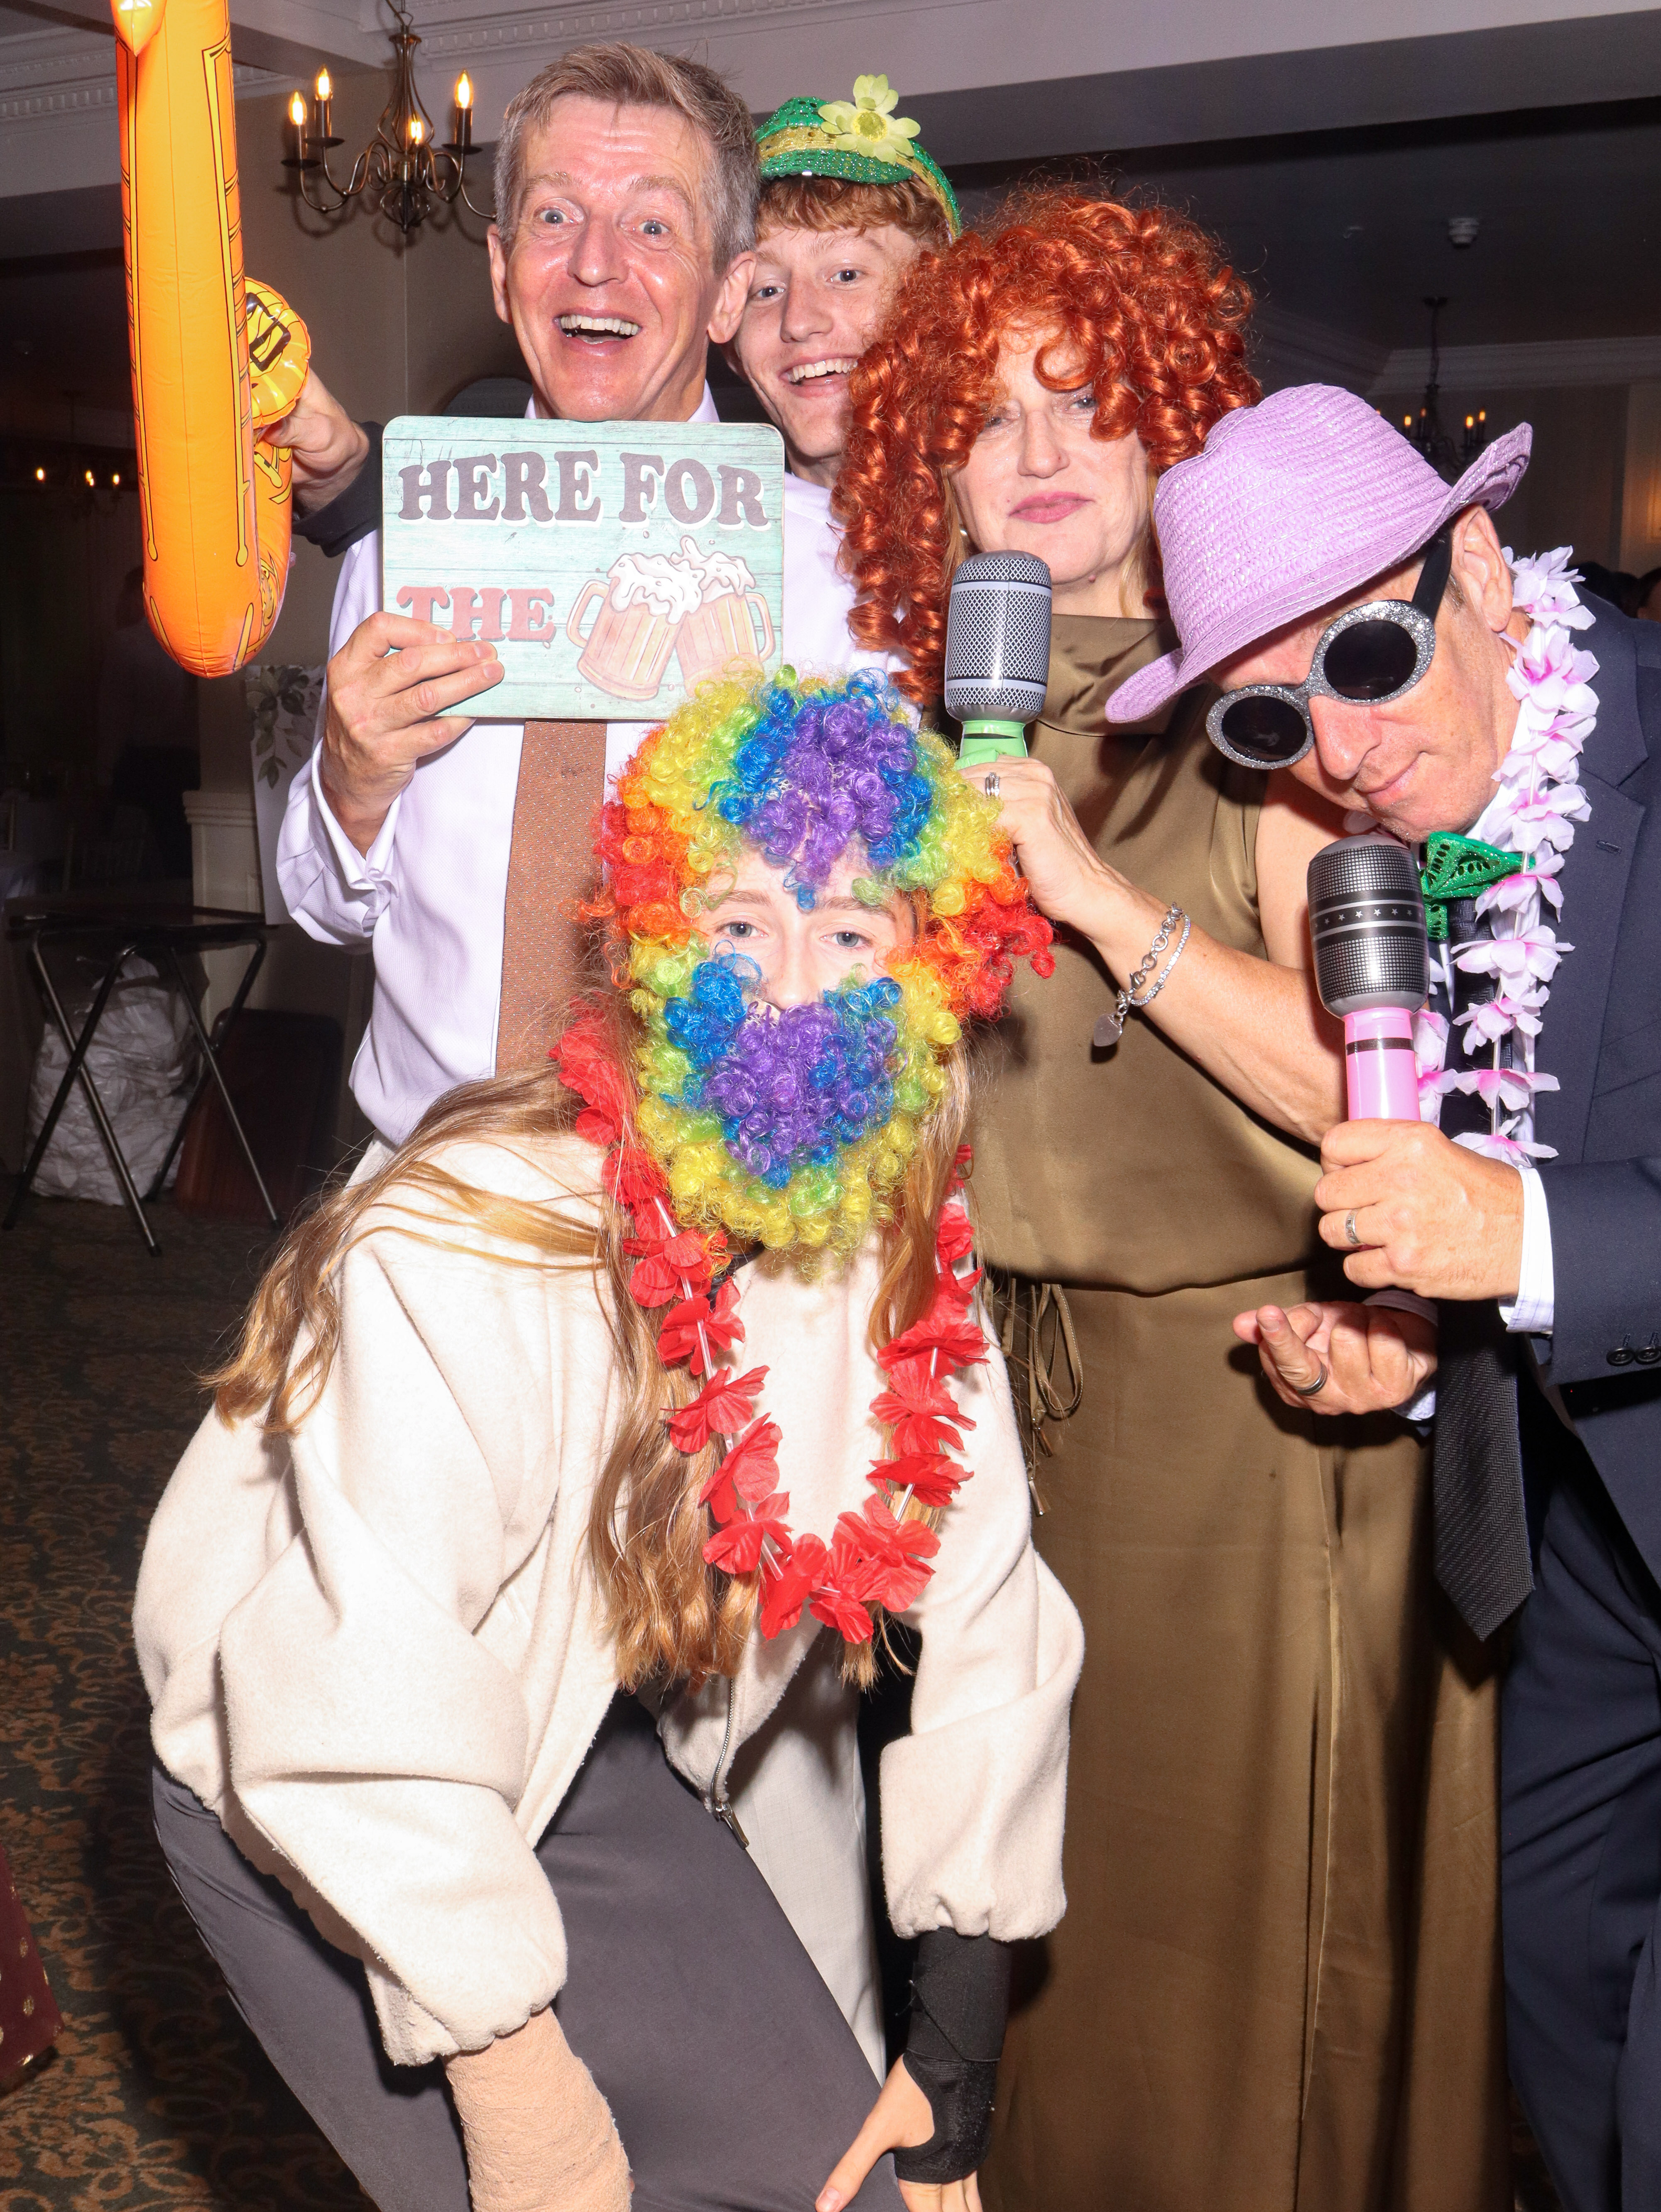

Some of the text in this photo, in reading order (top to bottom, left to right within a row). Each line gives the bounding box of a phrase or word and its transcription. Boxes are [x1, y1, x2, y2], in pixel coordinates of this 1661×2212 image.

[397, 450, 769, 529] HERE FOR
[396, 585, 555, 641] THE
